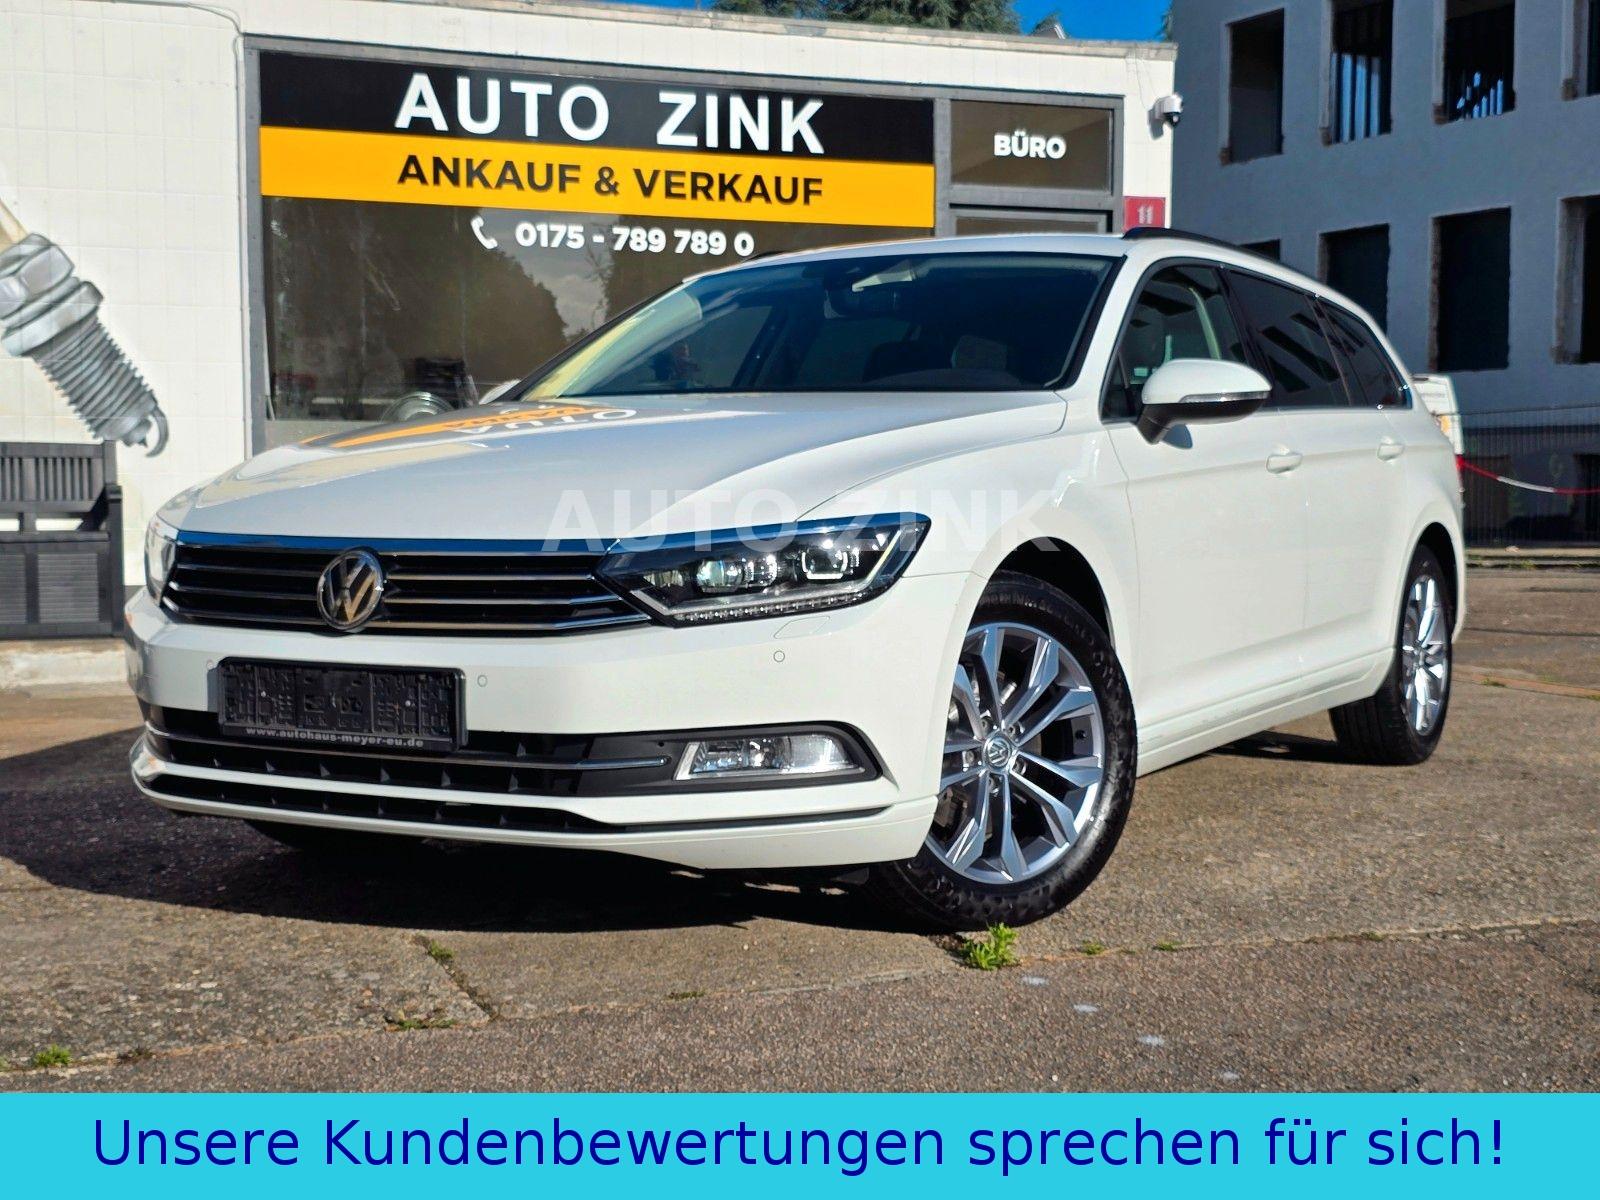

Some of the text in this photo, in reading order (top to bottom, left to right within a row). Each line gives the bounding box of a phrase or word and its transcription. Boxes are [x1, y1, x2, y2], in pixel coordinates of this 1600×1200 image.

[394, 73, 825, 155] AUTO ZINK
[993, 130, 1067, 160] BÜRO
[397, 154, 823, 207] ANKAUF & VERKAUF
[1137, 204, 1154, 225] 11
[514, 221, 586, 250] 0175
[613, 226, 666, 255] 789
[674, 228, 726, 256] 789
[733, 233, 755, 257] 0
[246, 727, 424, 748] www.autohaus-meyer-eu.de
